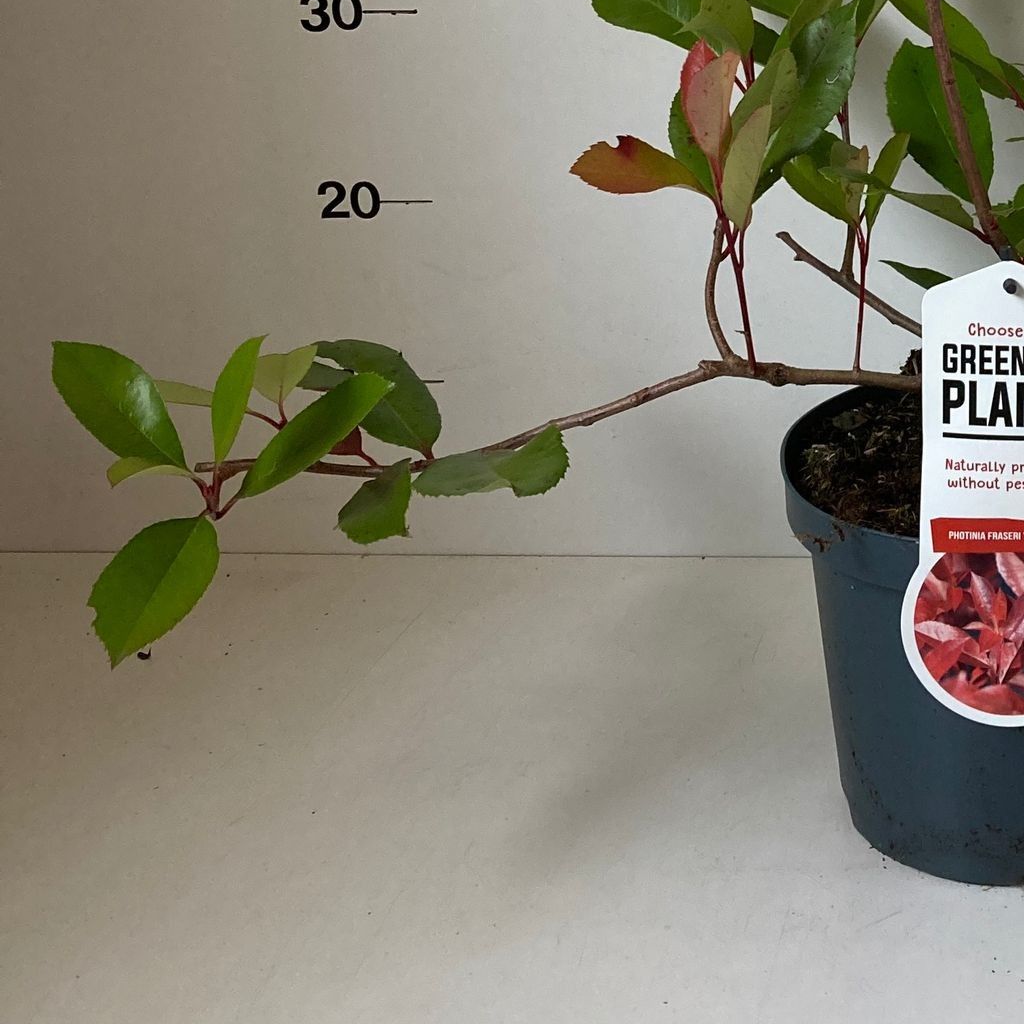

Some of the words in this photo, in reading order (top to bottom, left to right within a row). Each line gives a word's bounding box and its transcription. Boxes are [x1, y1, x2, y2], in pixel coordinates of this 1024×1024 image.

[317, 180, 381, 220] 20
[968, 323, 1023, 338] Choose
[945, 458, 1006, 474] Naturally
[947, 476, 1000, 489] without
[948, 530, 986, 541] PHOTINIA
[987, 531, 1021, 541] FRASERI
